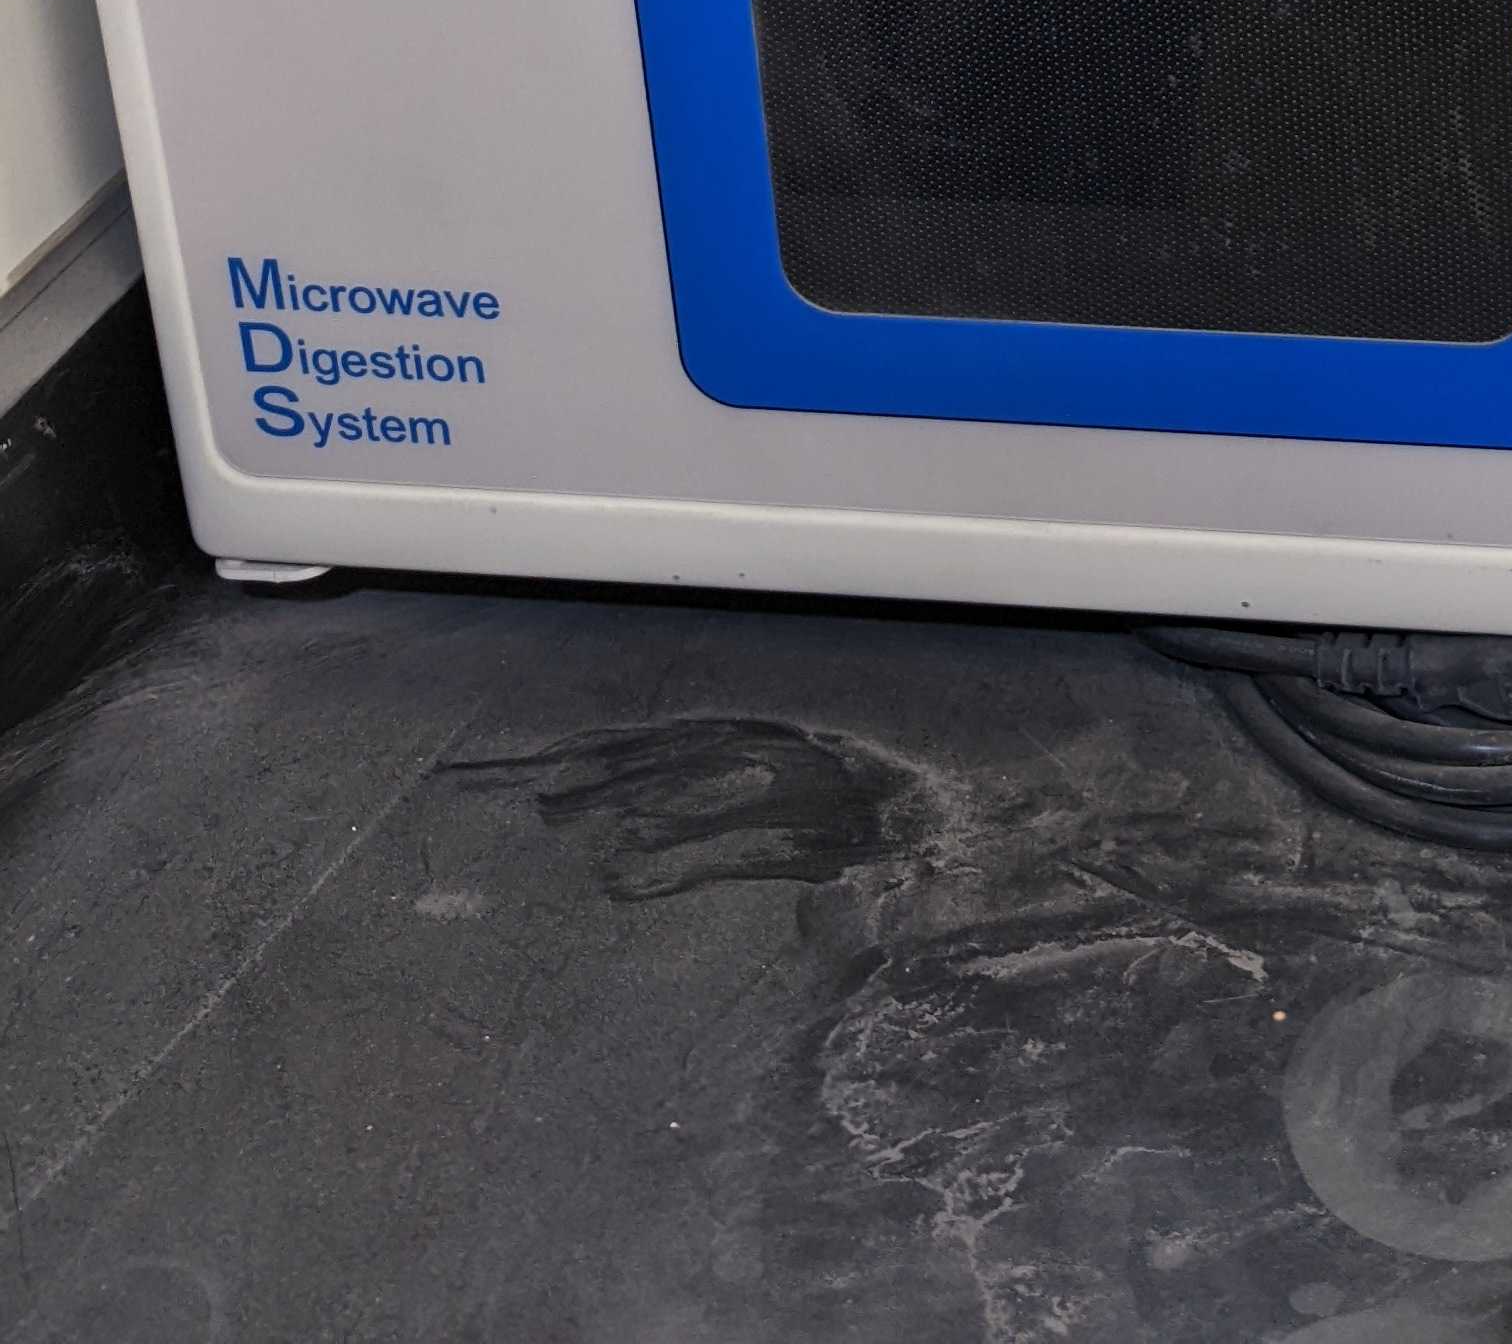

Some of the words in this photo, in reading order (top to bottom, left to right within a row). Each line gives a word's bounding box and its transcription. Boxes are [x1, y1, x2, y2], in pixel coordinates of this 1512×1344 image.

[226, 256, 501, 321] Microwave
[238, 320, 486, 387] Digestion
[252, 384, 452, 449] System
